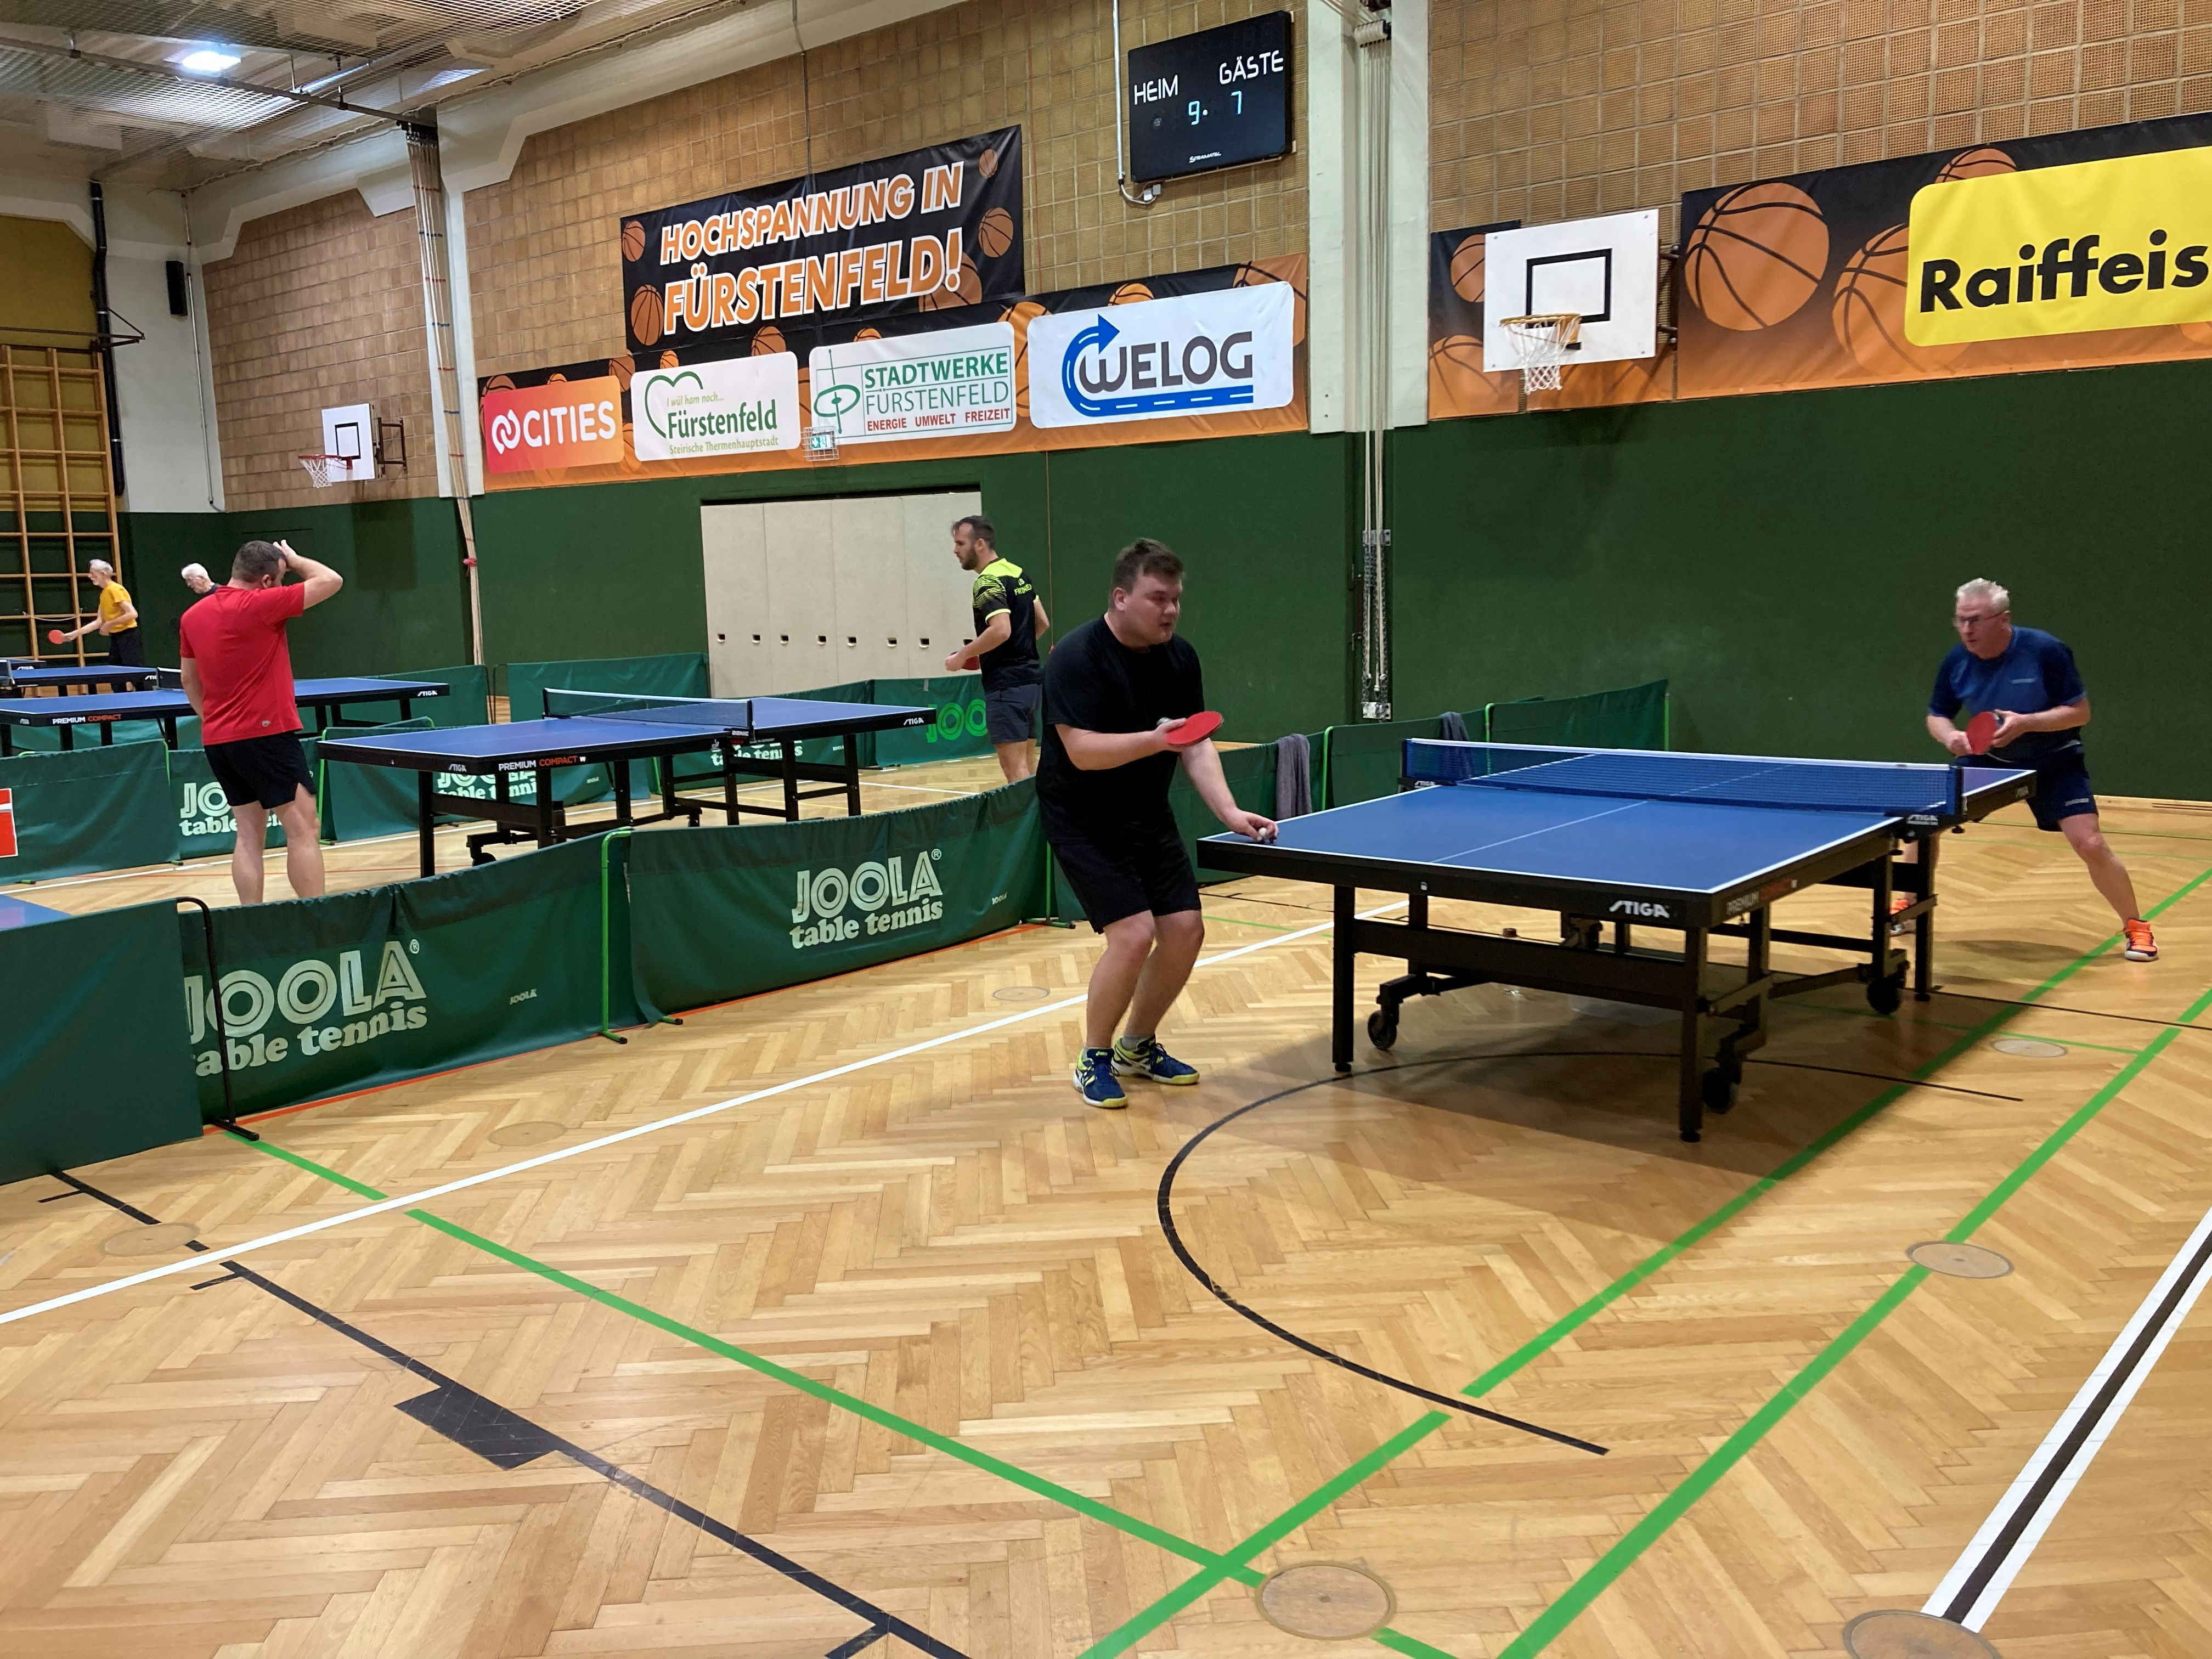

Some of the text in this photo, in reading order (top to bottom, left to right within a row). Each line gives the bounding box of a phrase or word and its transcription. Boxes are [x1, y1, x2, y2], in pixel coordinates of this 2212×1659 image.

[1134, 50, 1284, 105] HEIM GÄSTE
[1231, 90, 1242, 115] 7
[660, 161, 964, 266] HOCHSPANNUNG IN
[663, 227, 963, 335] FÜRSTENFELD!
[1920, 229, 2209, 313] Raiffeis
[865, 352, 1008, 388] STADTWERKE
[1079, 331, 1253, 394] WELOG
[685, 394, 699, 405] ham
[866, 381, 1009, 415] FÜRSTENFELD
[523, 401, 616, 447] CITIES
[668, 399, 777, 439] Fürstenfeld
[867, 408, 1010, 431] ENERGIE UMWELT FREIZEIT
[670, 435, 778, 455] Steirische Thermenhauptstadt
[904, 717, 924, 726] STIGA
[448, 763, 467, 772] STIGA
[498, 760, 537, 771] PREMIUM
[539, 755, 578, 766] COMPACT
[789, 898, 943, 949] table tennis
[1609, 900, 1670, 918] STIGA
[194, 1001, 427, 1077] able tennis
